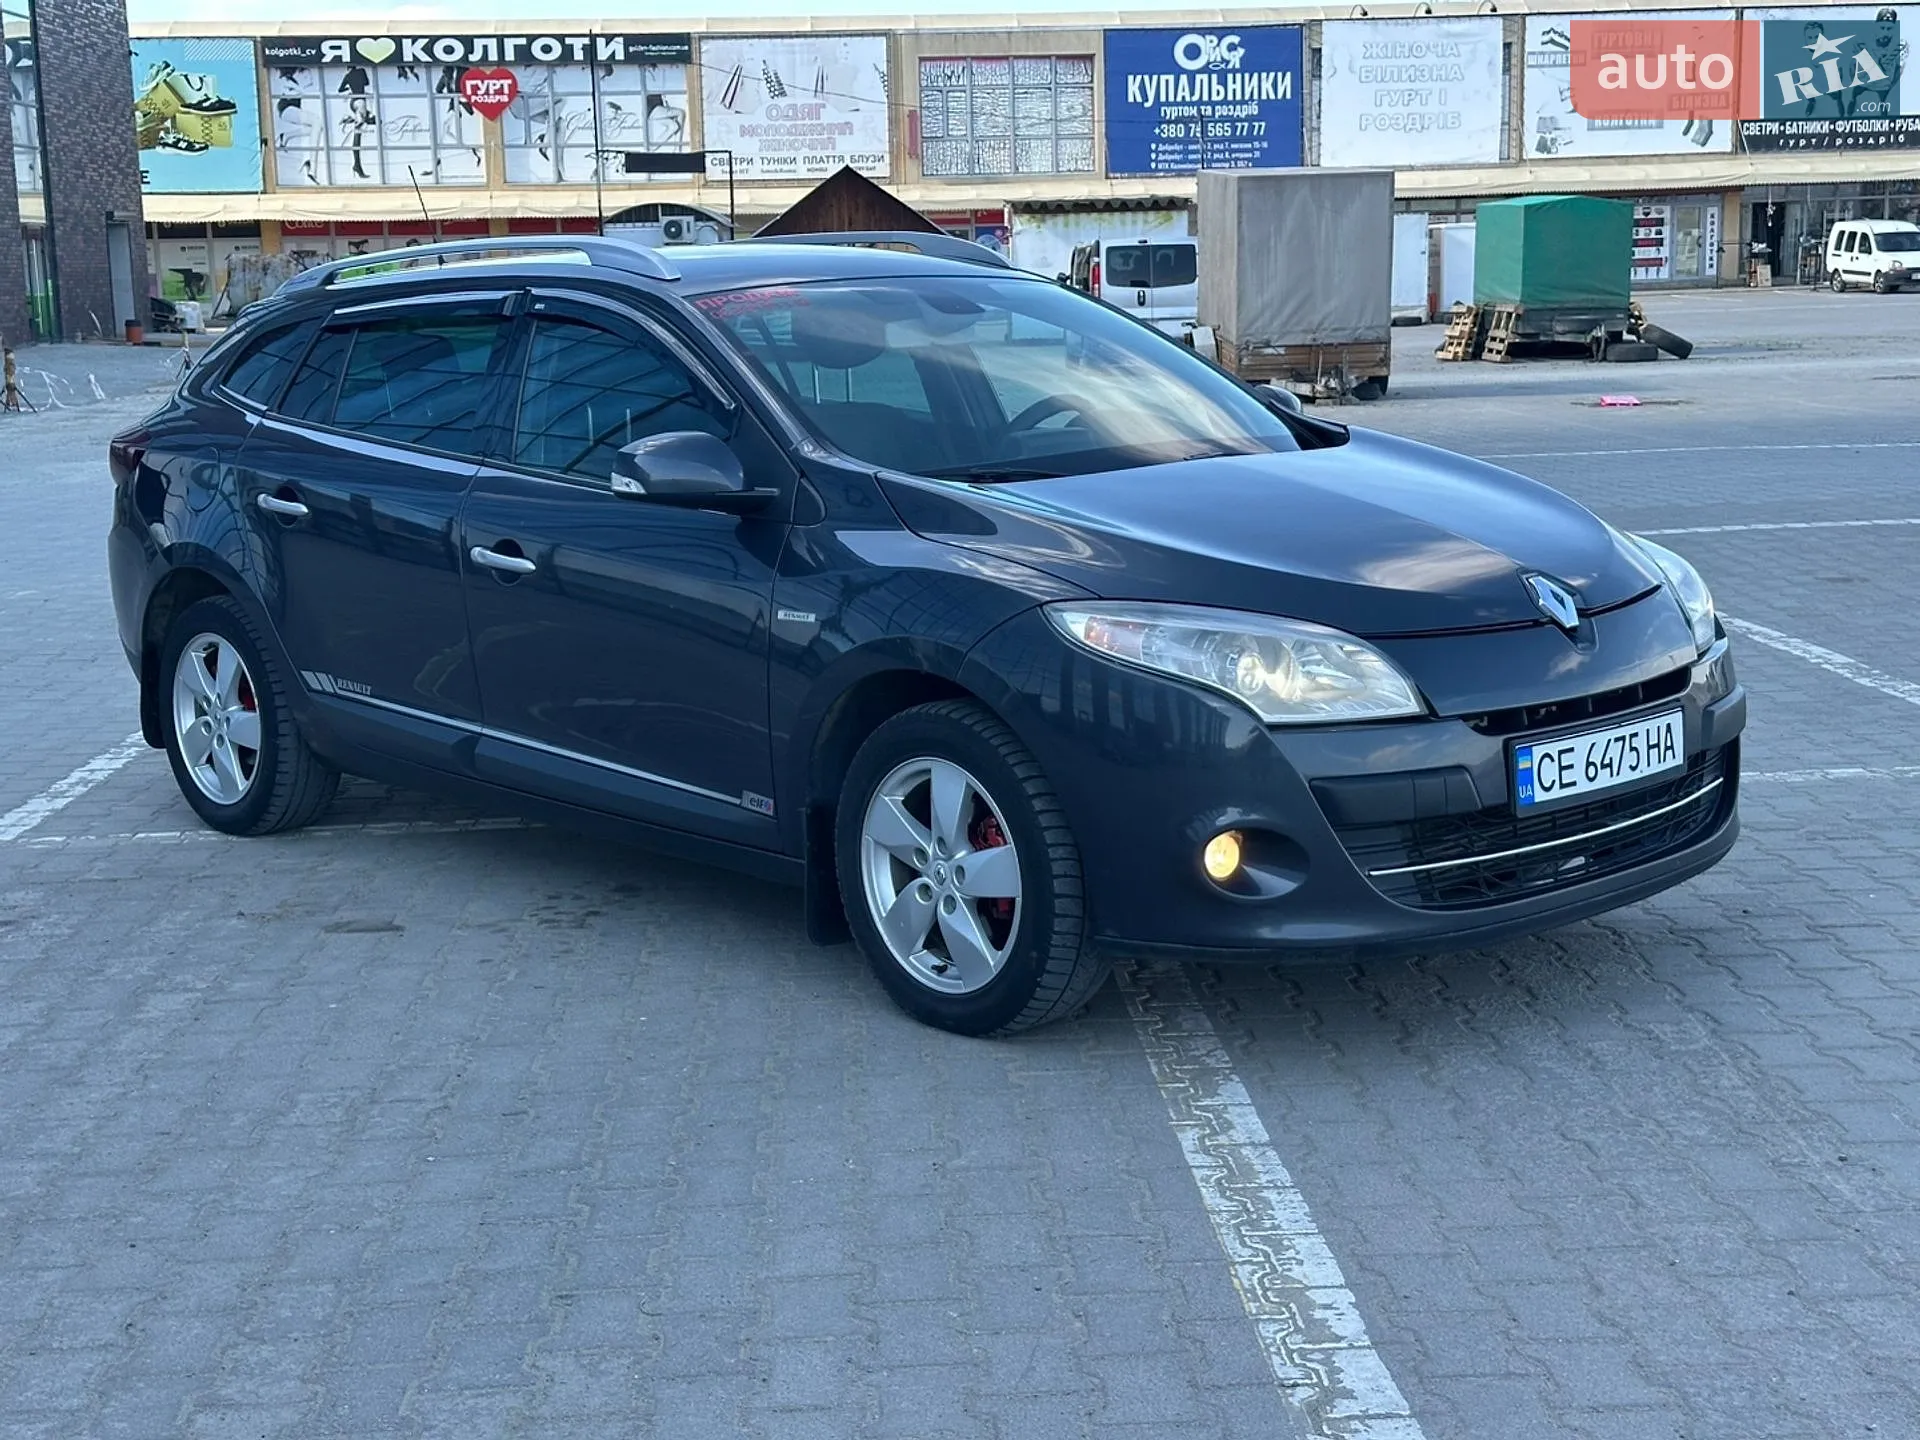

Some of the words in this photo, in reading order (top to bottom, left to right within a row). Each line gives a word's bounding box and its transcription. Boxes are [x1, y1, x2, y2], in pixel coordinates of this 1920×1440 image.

[321, 39, 350, 62] Я
[402, 36, 625, 62] КОЛГОТИ
[1362, 41, 1460, 59] ЖІНОЧА
[1359, 64, 1464, 83] БІЛИЗНА
[465, 78, 513, 95] ГУРТ
[1127, 72, 1291, 107] КУПАЛЬНИКИ
[1375, 88, 1432, 107] ГУРТ
[1161, 106, 1198, 120] гуртом
[1201, 105, 1212, 116] та
[1215, 101, 1258, 118] роздріб
[1153, 123, 1184, 137] +380
[1207, 122, 1231, 136] 565
[1235, 122, 1248, 136] 77
[1252, 121, 1266, 135] 77
[1360, 111, 1461, 133] РОЗДРІБ
[1743, 121, 1779, 136] СВЕТРИ
[1785, 120, 1829, 134] БАТНИКИ
[1835, 119, 1889, 133] ФУТБОЛКИ
[760, 155, 797, 166] ТУНІКИ
[803, 154, 846, 165] ПЛАТТЯ
[850, 154, 885, 164] БЛУЗИ
[1537, 746, 1577, 793] CE
[1585, 731, 1640, 782] 6475
[1646, 722, 1676, 768] HA
[1519, 783, 1533, 798] UA
